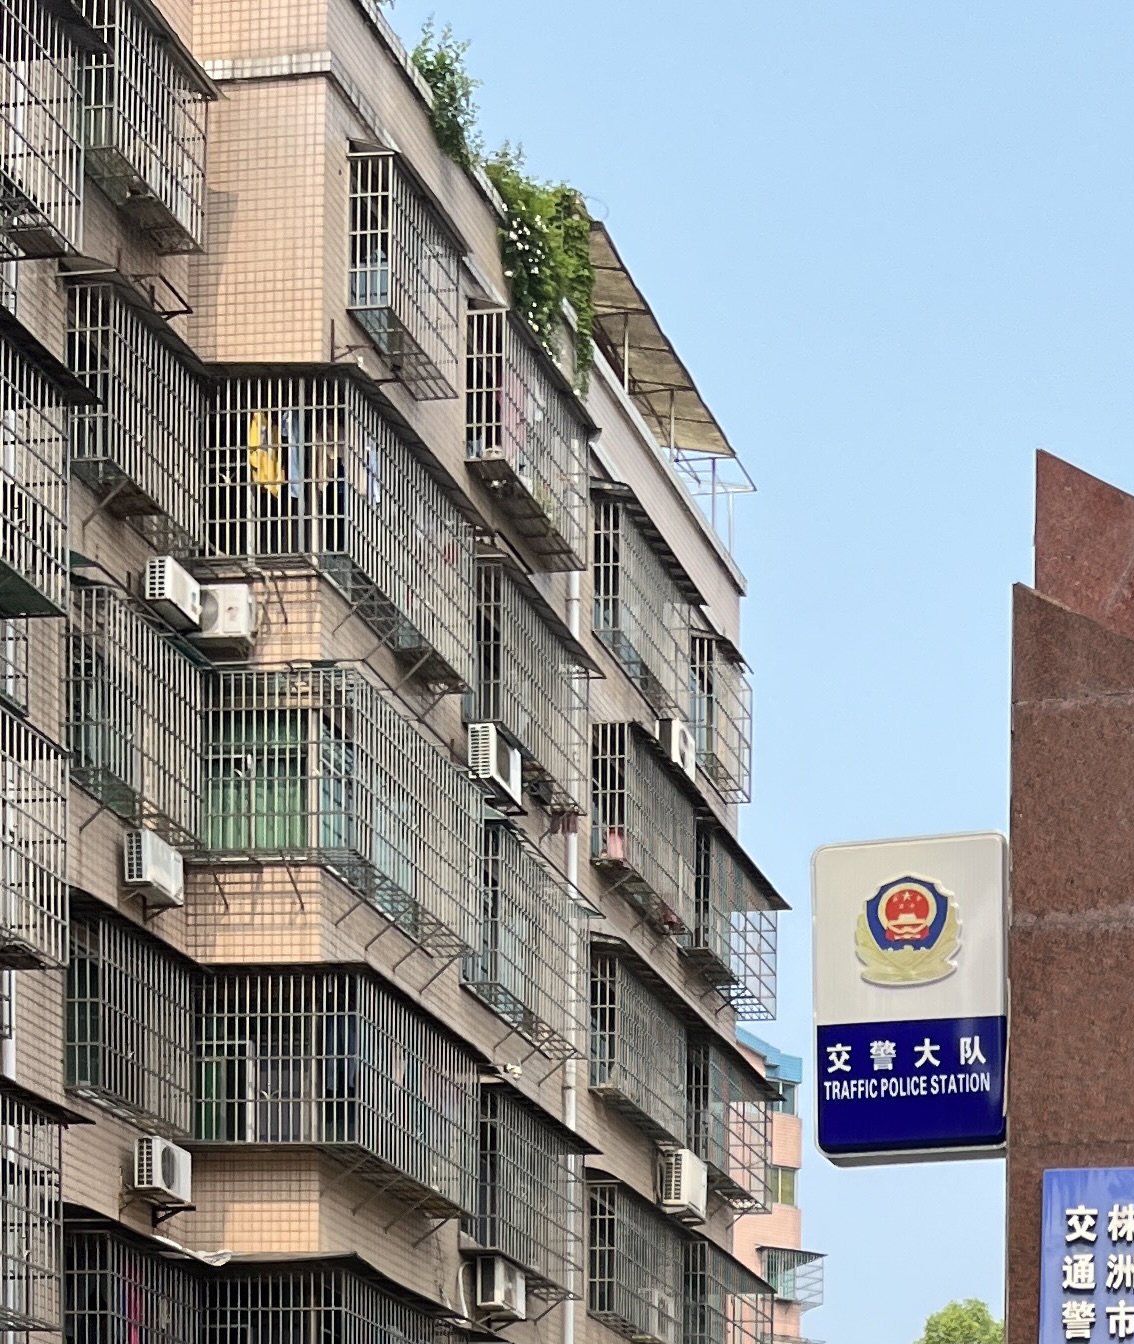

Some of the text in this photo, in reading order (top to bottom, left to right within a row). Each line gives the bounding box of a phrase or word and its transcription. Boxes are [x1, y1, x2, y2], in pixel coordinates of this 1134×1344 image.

[826, 1036, 987, 1073] 交警大队
[824, 1072, 991, 1100] TRAFFIC POLICE STATION
